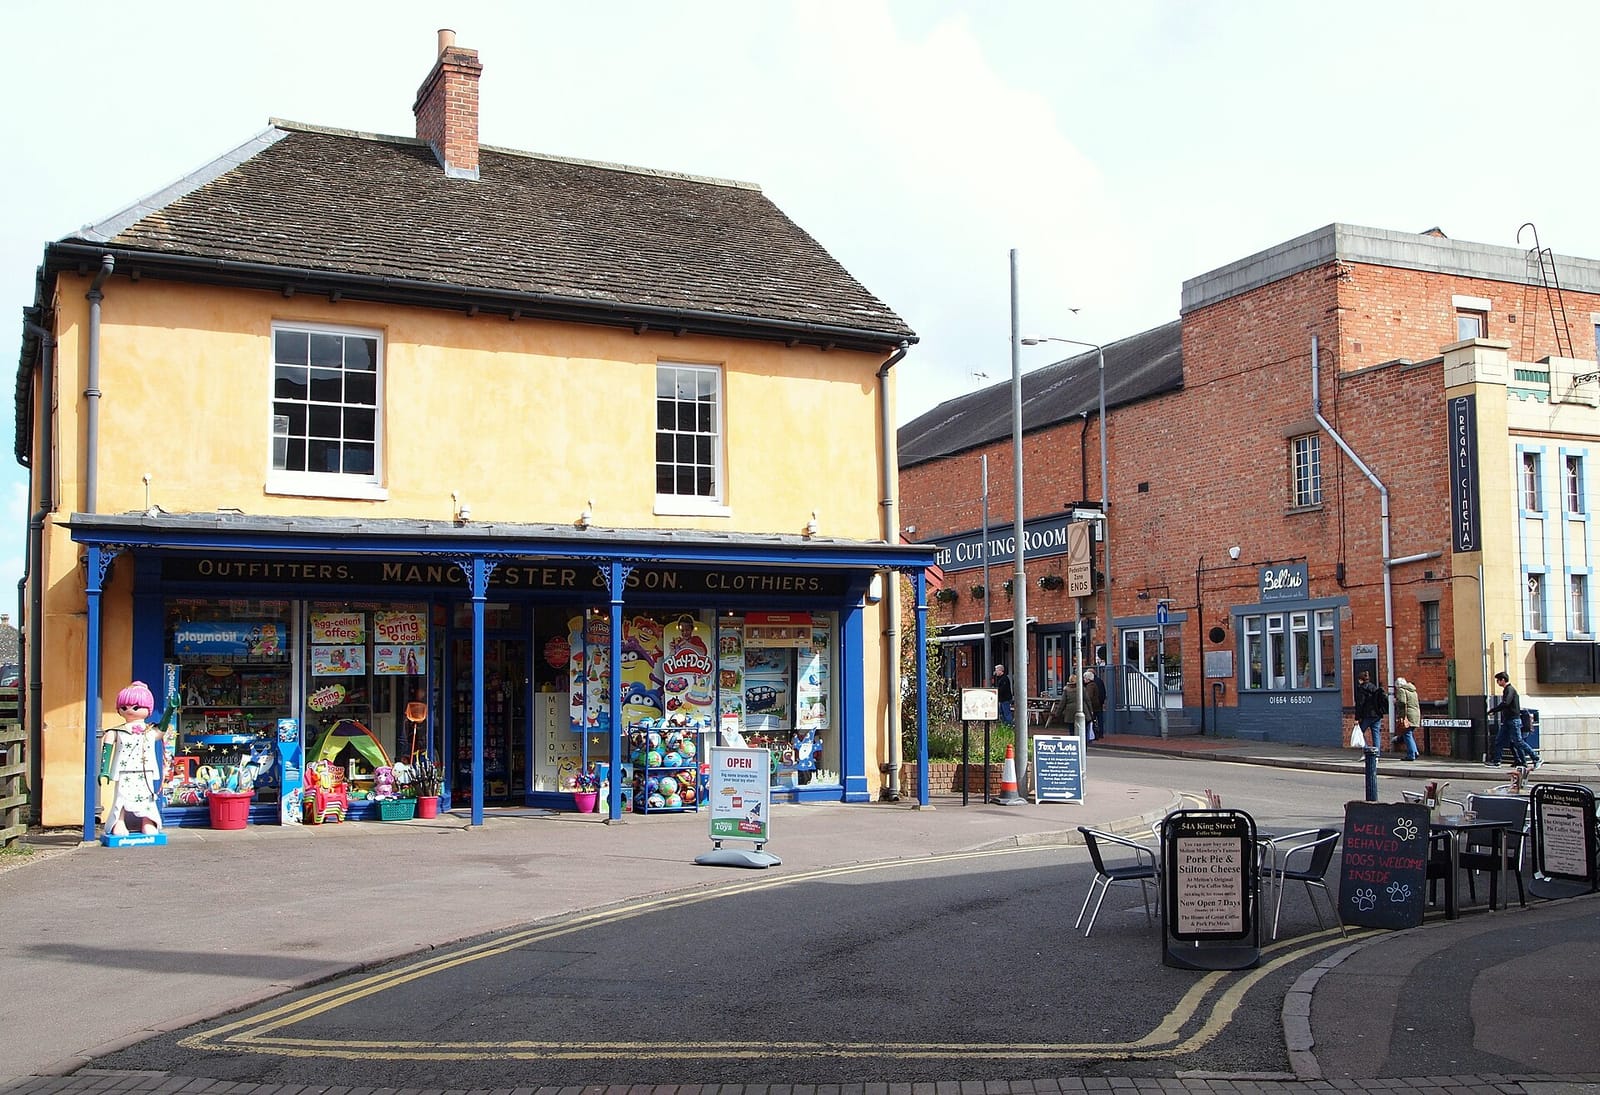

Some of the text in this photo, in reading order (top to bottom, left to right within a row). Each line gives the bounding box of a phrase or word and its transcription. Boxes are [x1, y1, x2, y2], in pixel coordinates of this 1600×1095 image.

[1459, 415, 1470, 542] REGAL CINEMA
[936, 548, 952, 565] HE
[1023, 527, 1067, 551] ROOM
[199, 559, 355, 579] OUTFITTERS.
[382, 562, 577, 586] MANCESTER
[706, 573, 825, 592] CLOTHIERS.
[1263, 568, 1303, 594] Bellini
[1070, 581, 1088, 592] ENDS
[315, 618, 361, 628] egg-cellent
[379, 621, 418, 637] Spring
[177, 631, 237, 644] playmobil
[325, 627, 356, 638] offers
[665, 653, 711, 673] Play-Doh
[312, 690, 340, 706] Spring
[548, 695, 556, 763] MELTON
[727, 757, 752, 769] OPEN
[715, 822, 732, 832] Toys
[1197, 822, 1214, 831] King
[1215, 822, 1236, 830] Street
[1353, 823, 1387, 835] WELL
[1347, 838, 1399, 851] BEHAVED
[1186, 855, 1208, 863] Pork
[1210, 855, 1224, 863] Pie
[1345, 853, 1424, 870] DOGS WELCOME
[1179, 864, 1241, 873] Stilton Cheese
[1348, 869, 1392, 883] INSIDE
[1197, 900, 1216, 908] Open
[1223, 900, 1241, 908] Days
